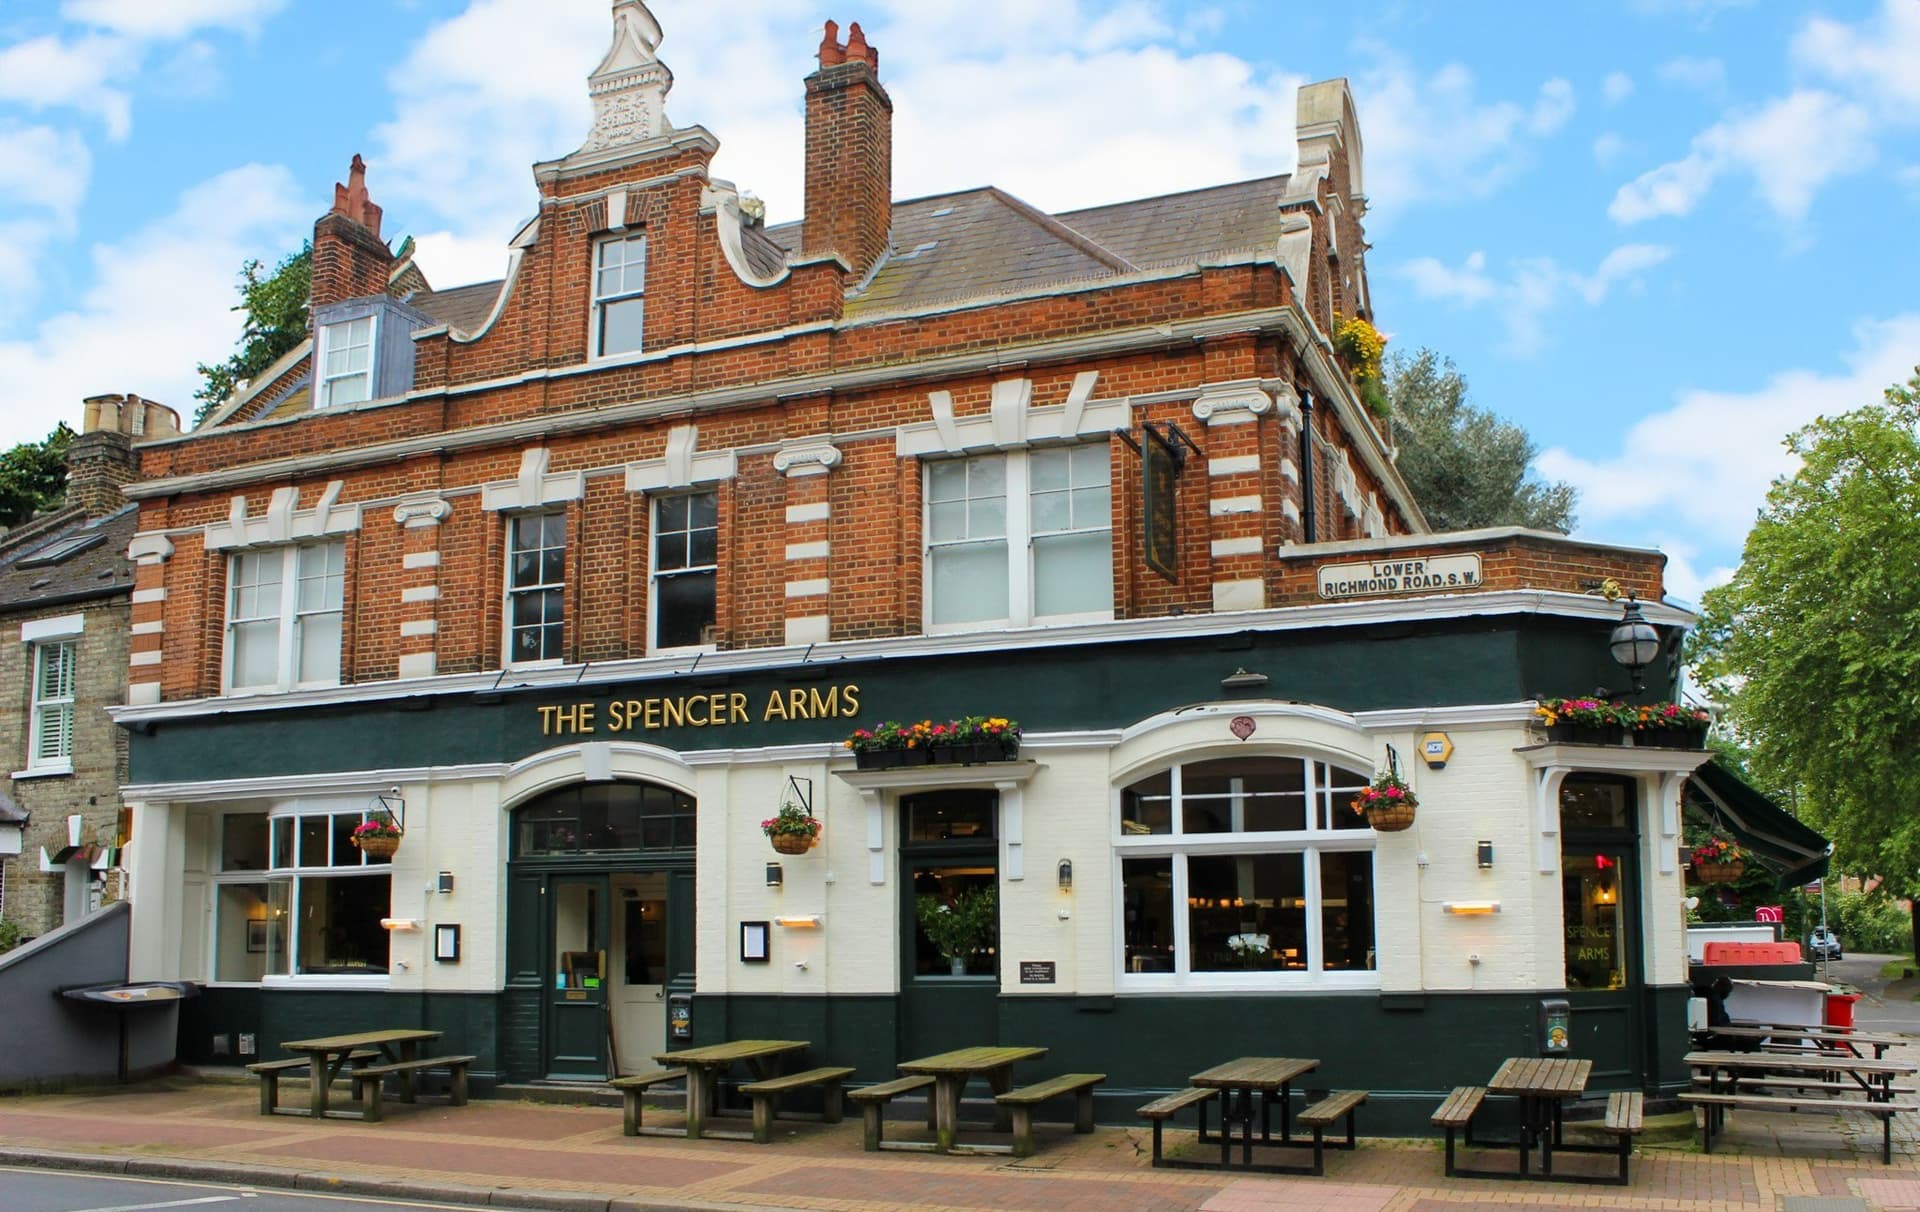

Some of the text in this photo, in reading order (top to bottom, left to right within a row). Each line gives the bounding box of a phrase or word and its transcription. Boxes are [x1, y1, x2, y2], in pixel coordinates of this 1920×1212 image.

[1373, 562, 1424, 578] LOWER
[1325, 578, 1397, 595] RICHMOND
[537, 684, 860, 735] THE SPENCER ARMS
[1577, 947, 1609, 960] ARMS
